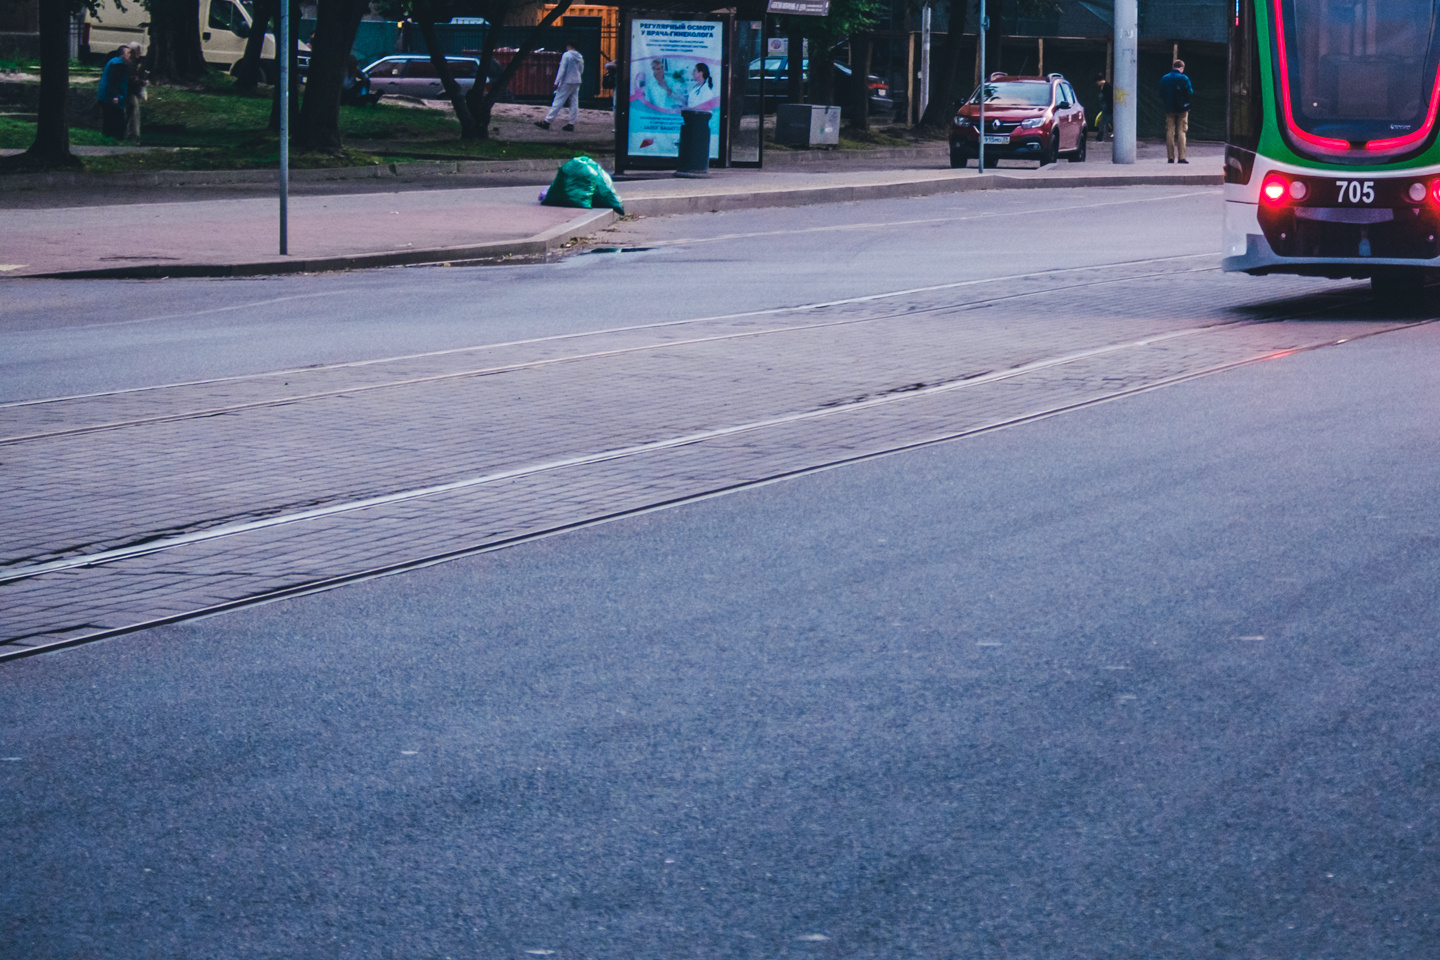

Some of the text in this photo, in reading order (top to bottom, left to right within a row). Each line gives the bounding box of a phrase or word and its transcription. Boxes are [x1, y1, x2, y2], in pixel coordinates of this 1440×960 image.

[639, 22, 686, 30] РЕГУЛЯРНЫЙ
[646, 30, 714, 38] ВРАЧА-ГИНЕКОЛОГА
[1335, 180, 1375, 204] 705
